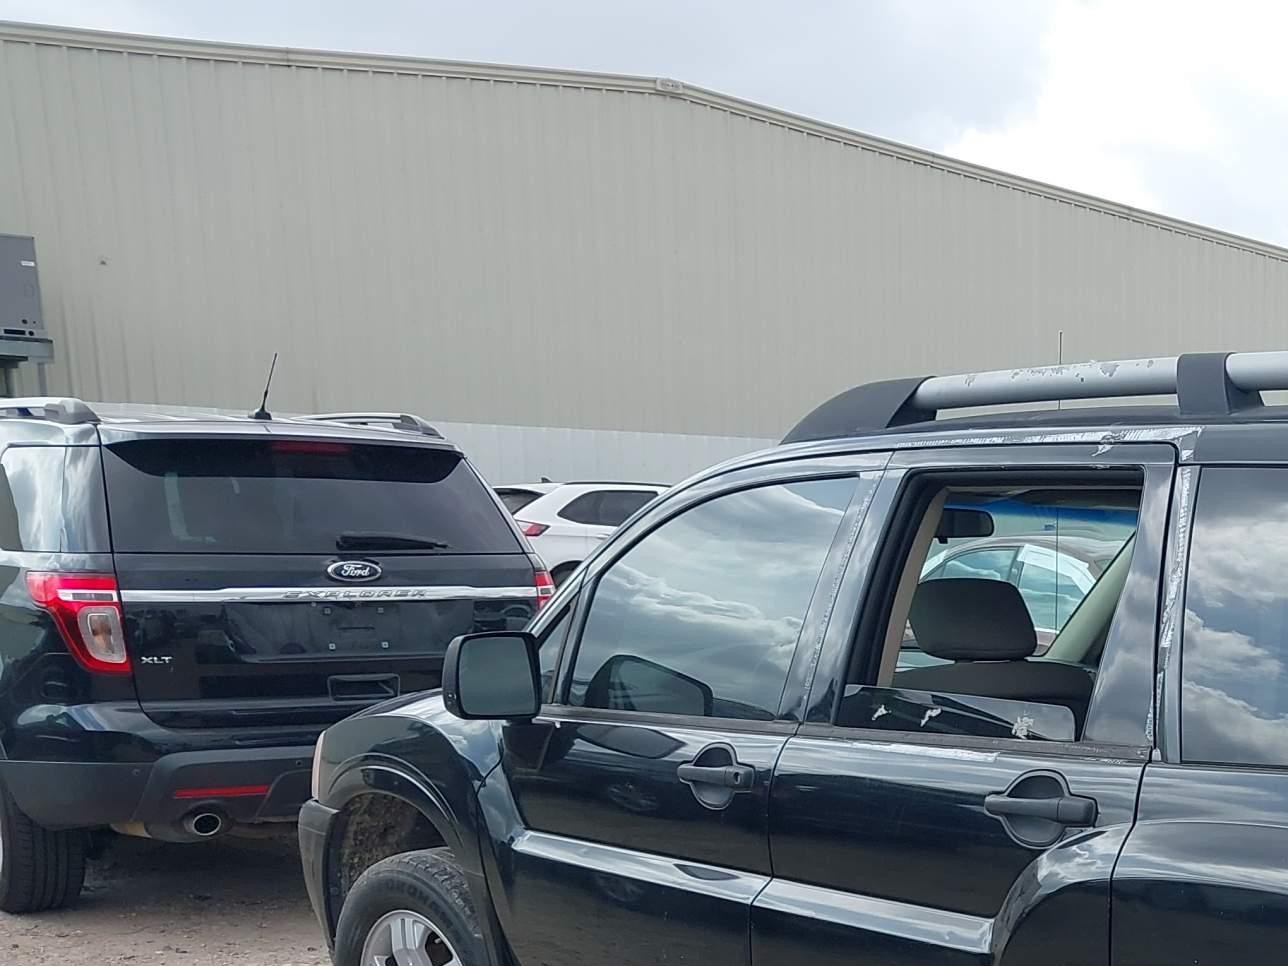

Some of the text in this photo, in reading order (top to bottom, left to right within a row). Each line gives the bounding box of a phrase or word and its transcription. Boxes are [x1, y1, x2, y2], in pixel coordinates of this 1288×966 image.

[340, 563, 371, 577] Ford
[283, 589, 427, 599] EXPLORER
[140, 656, 173, 664] XLT
